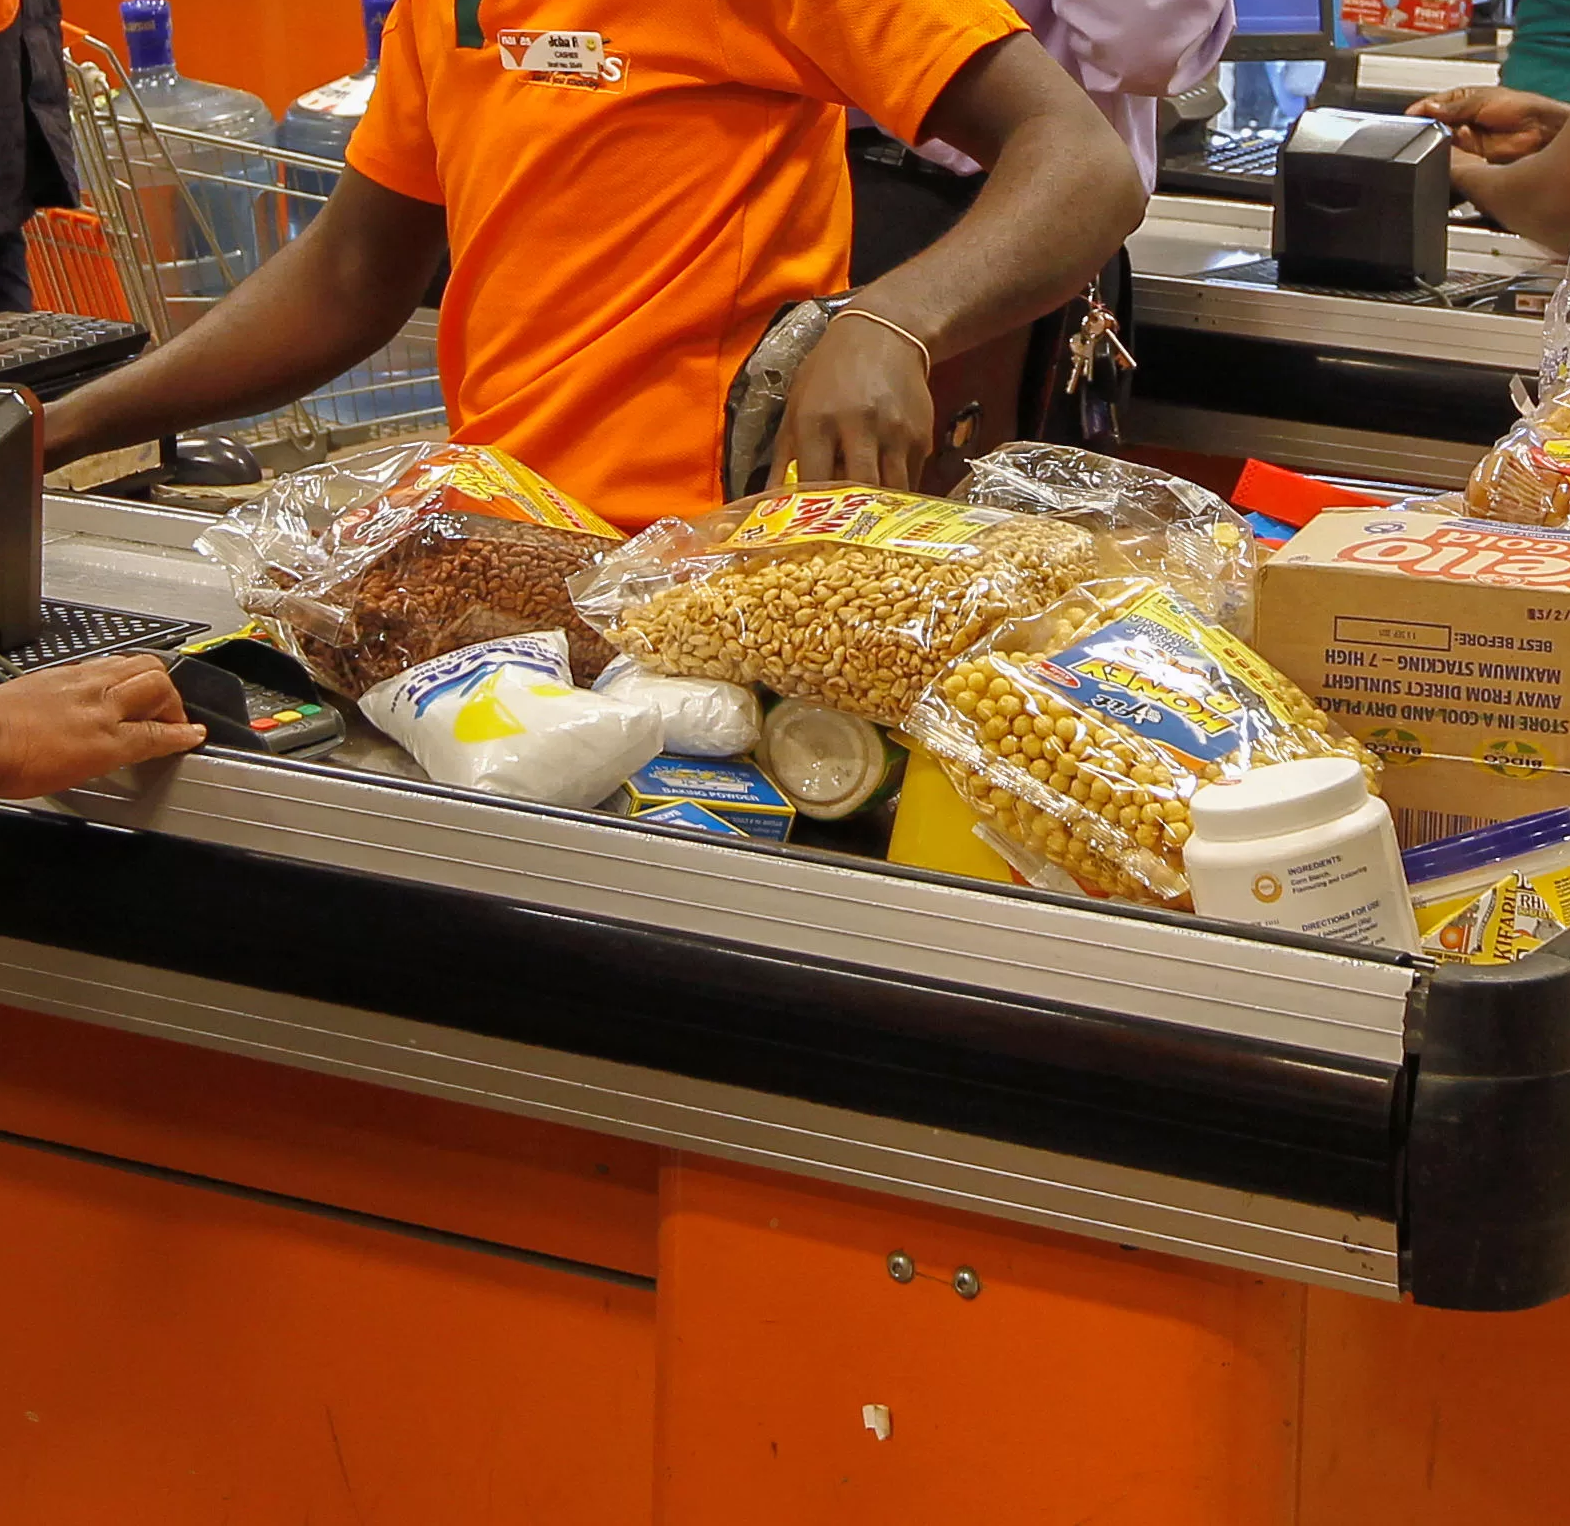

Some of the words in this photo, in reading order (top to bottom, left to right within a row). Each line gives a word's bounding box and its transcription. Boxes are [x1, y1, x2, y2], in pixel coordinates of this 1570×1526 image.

[1439, 529, 1570, 555] Gold
[1454, 632, 1514, 650] BEFORE:
[1517, 637, 1553, 653] BEST
[1325, 649, 1364, 667] HIGH
[1369, 653, 1379, 668] 7
[1397, 655, 1475, 676] STACKING
[1479, 662, 1562, 684] MAXIMUM
[1322, 673, 1402, 694] SUNLIGHT
[1405, 683, 1461, 700] DIRECT
[1071, 658, 1238, 736] HONEY
[1466, 689, 1511, 706] FROM
[1515, 692, 1563, 709] AWAY
[1366, 700, 1397, 718] DRY
[1401, 704, 1432, 722] AND
[1443, 707, 1479, 725] COOL
[1484, 712, 1494, 727] A
[1498, 714, 1515, 731] IN
[1520, 716, 1570, 734] STORE
[1364, 742, 1423, 755] BIDCO
[1483, 754, 1543, 770] BIDCO
[662, 787, 708, 798] BAKING
[708, 790, 760, 802] POWDER
[1287, 855, 1343, 876] INGREDIENTS
[1292, 881, 1328, 894] Flavouring
[1328, 876, 1340, 885] and
[1341, 866, 1368, 881] Colouring
[1301, 912, 1351, 932] DIRECTIONS
[1351, 905, 1366, 918] FOR
[1366, 900, 1380, 912] USE
[1493, 887, 1517, 962] KIFARU
